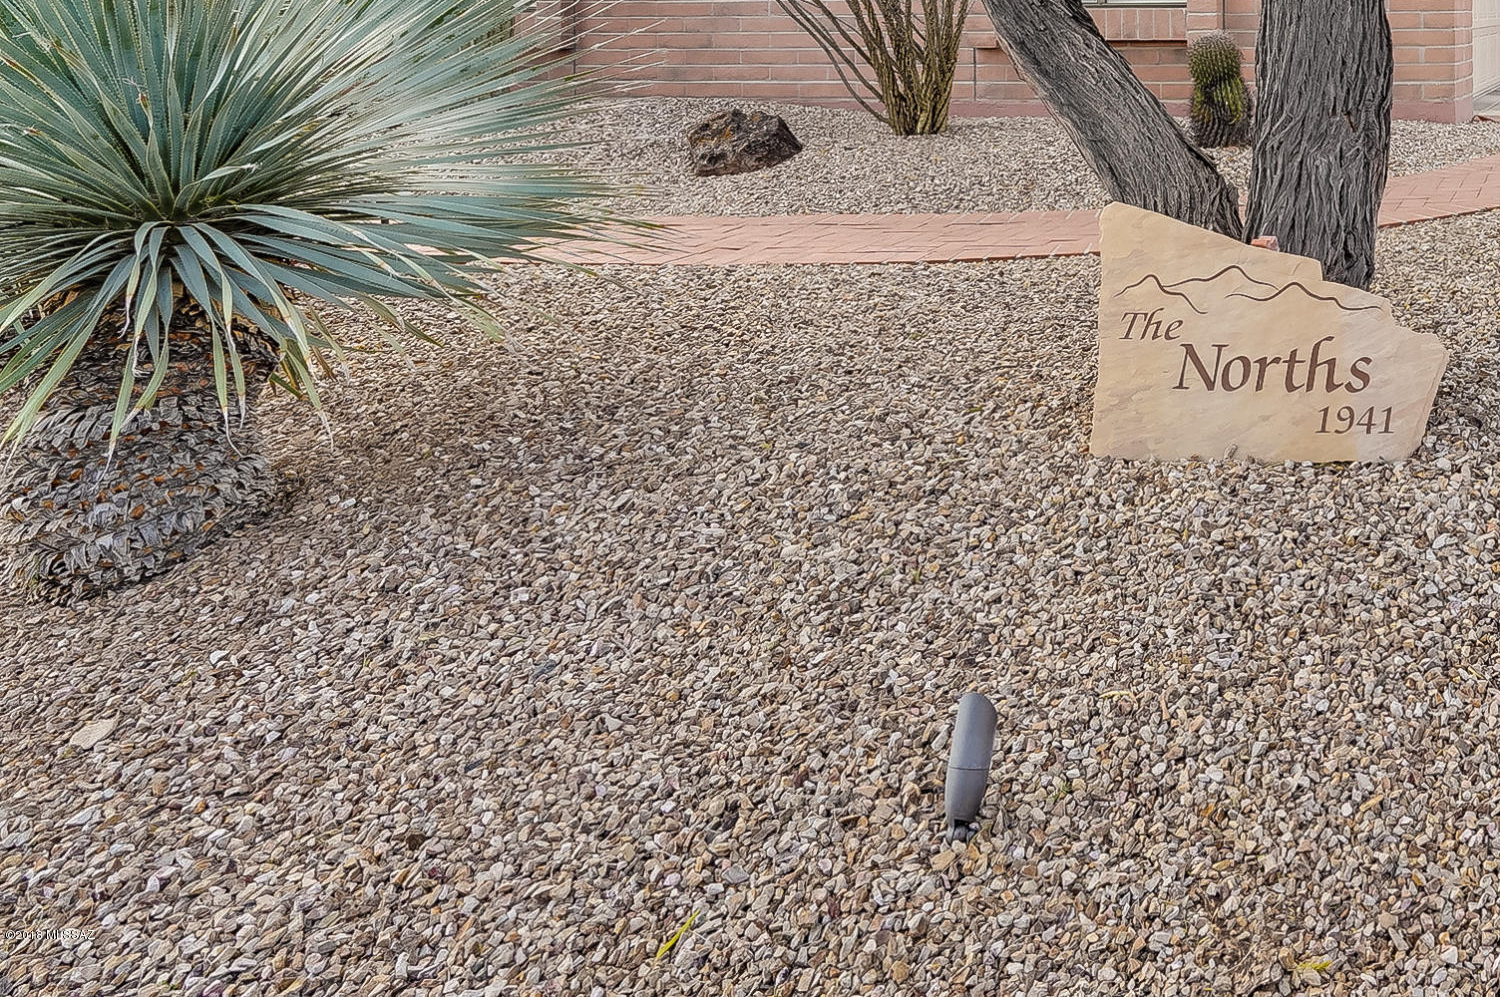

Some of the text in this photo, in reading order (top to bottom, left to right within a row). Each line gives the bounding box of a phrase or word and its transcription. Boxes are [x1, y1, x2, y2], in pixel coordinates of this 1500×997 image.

[1119, 307, 1184, 341] The
[1172, 336, 1373, 393] Norths
[1315, 405, 1395, 435] 1941
